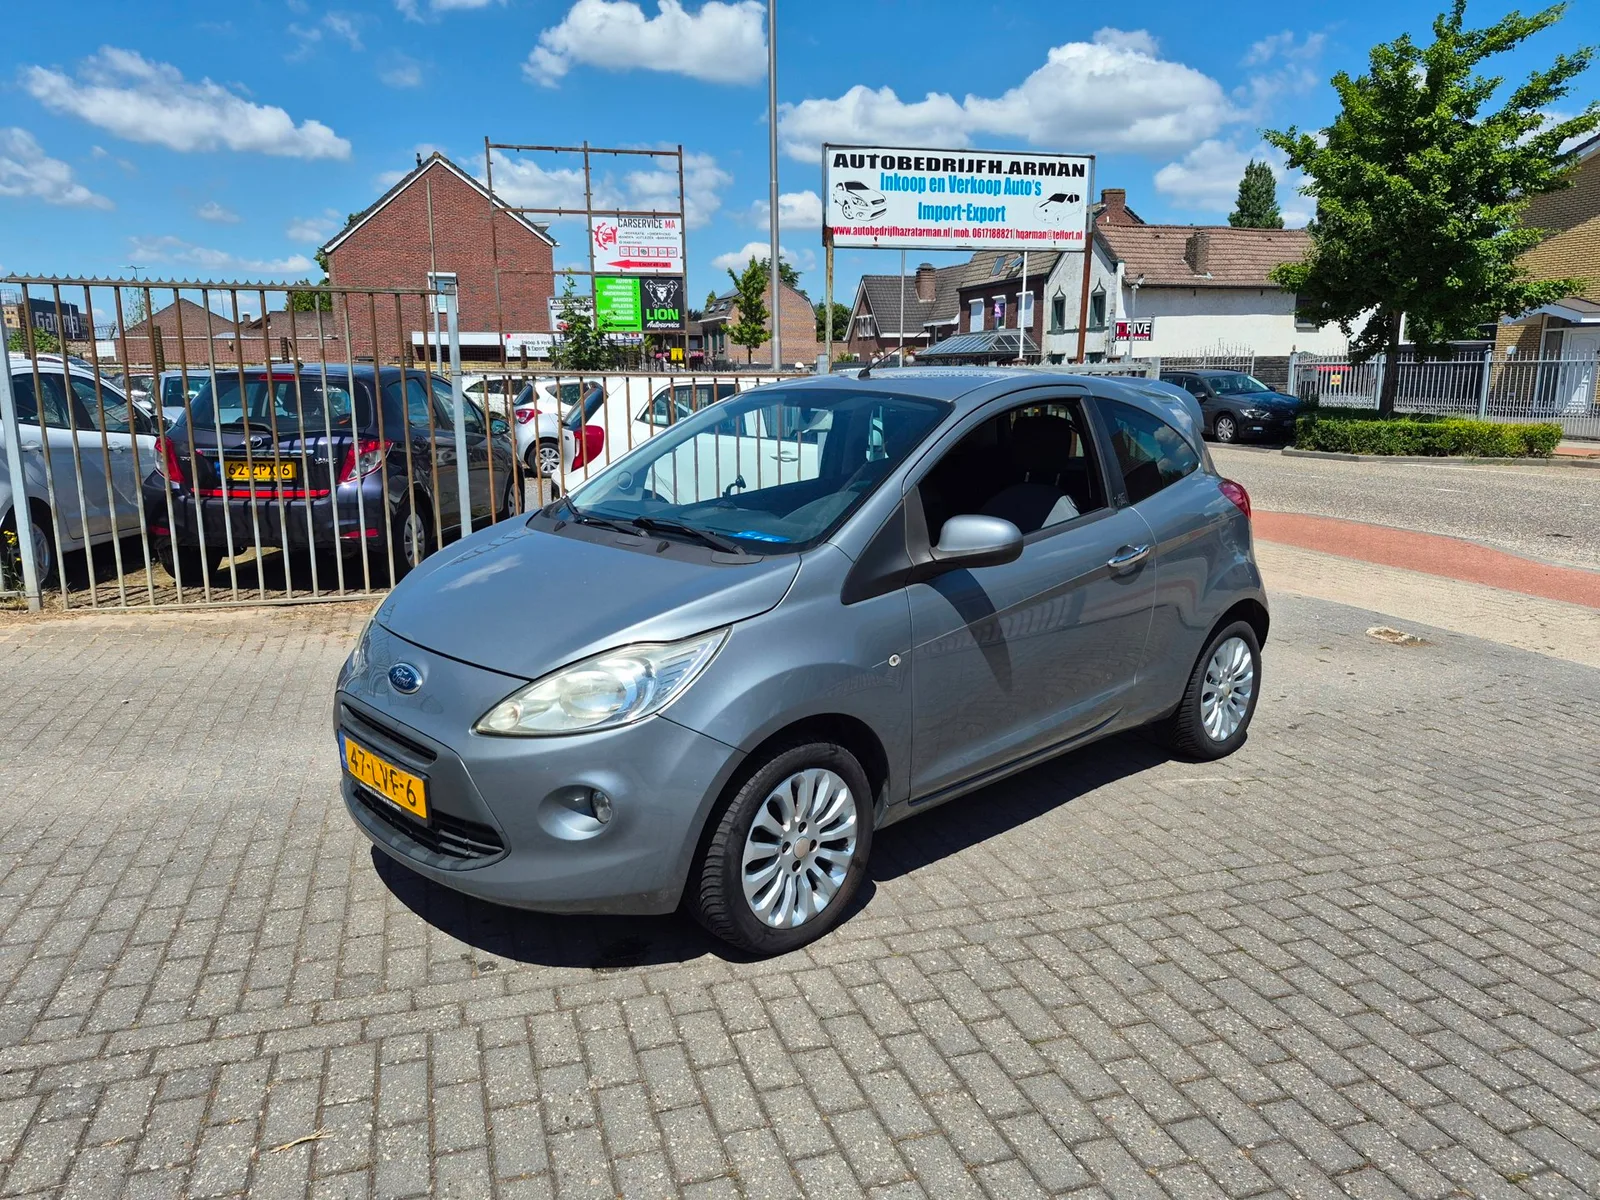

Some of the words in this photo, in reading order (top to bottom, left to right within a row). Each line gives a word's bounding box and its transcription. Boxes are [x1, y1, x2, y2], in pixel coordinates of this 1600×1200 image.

[880, 172, 926, 194] Inkoop
[929, 179, 945, 193] en
[948, 175, 1002, 197] Verkoop
[1004, 177, 1042, 197] Auto's
[917, 202, 1006, 223] Import-Export
[617, 218, 662, 229] CARSERVICE
[664, 219, 676, 229] MA
[646, 308, 679, 320] LION
[646, 320, 680, 328] Autoservice
[228, 463, 290, 476] 62-ZPX6
[393, 667, 412, 687] Ford
[350, 746, 416, 807] 47-LVF-6
